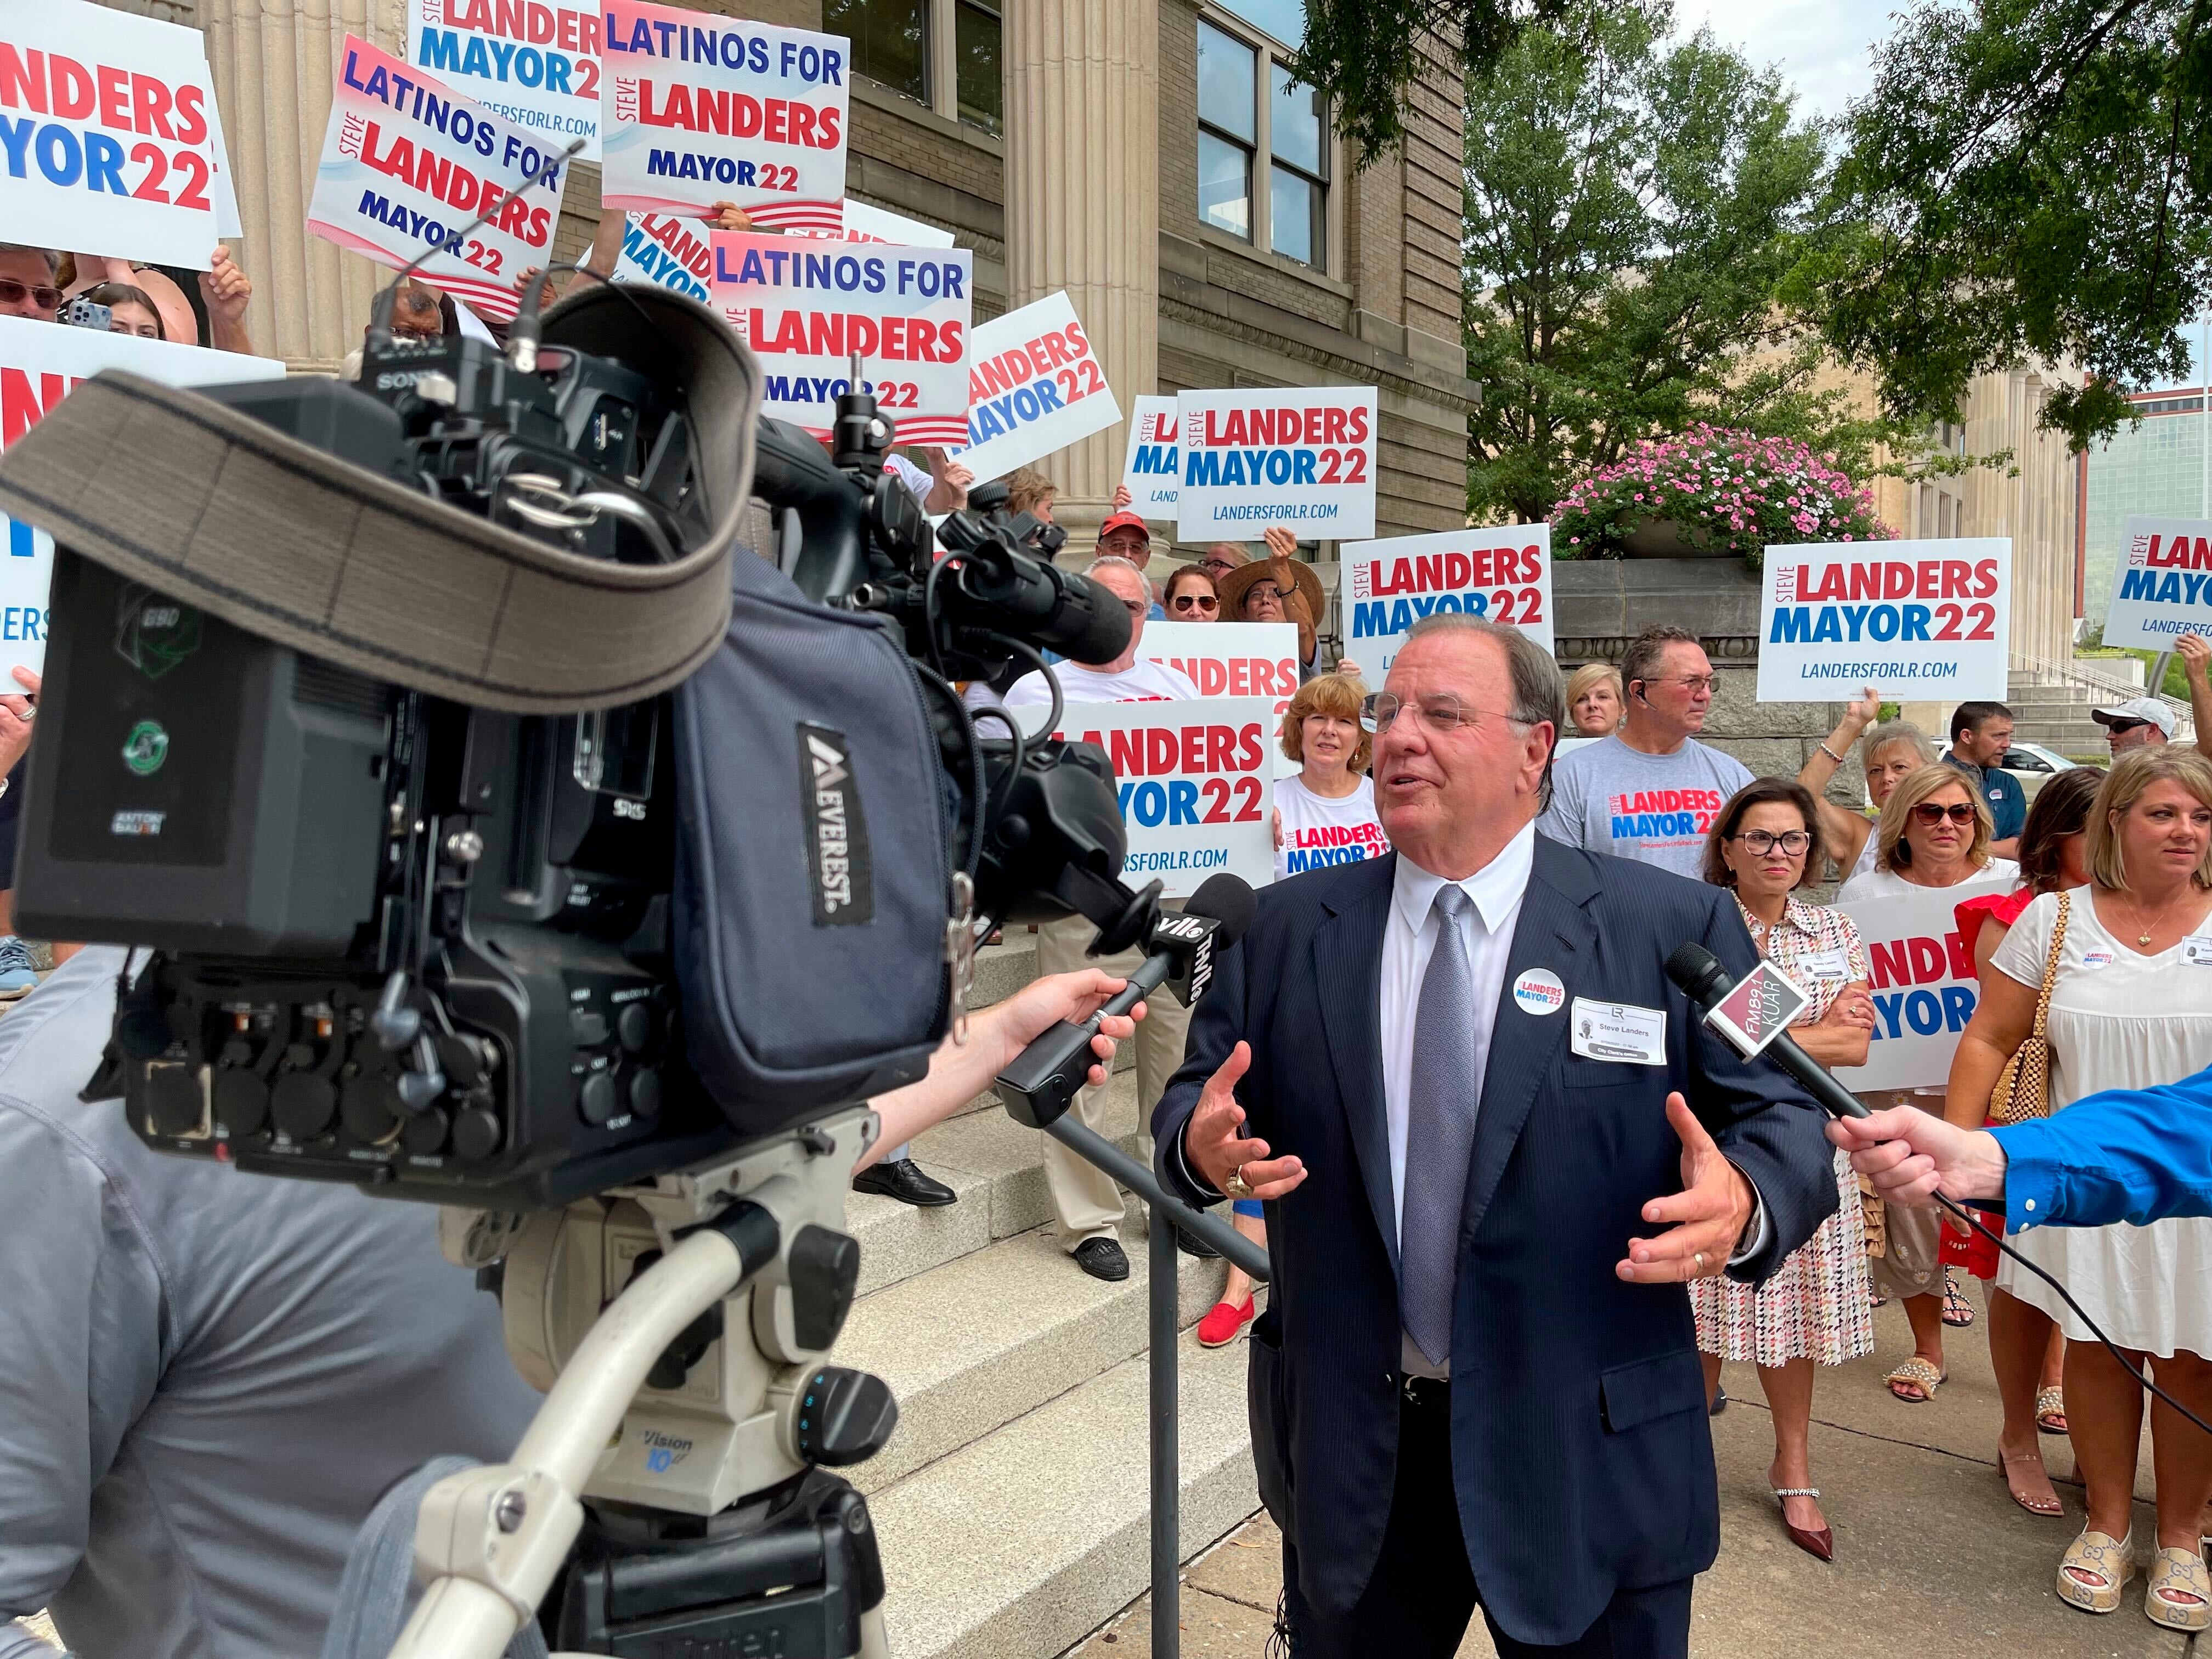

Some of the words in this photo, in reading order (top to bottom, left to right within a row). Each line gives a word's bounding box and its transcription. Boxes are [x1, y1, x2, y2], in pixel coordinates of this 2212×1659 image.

[443, 0, 601, 57] LANDER
[607, 13, 769, 74] LATINOS
[781, 42, 842, 86] FOR
[0, 42, 207, 145] NDERS
[617, 76, 636, 122] STEVE
[343, 50, 495, 156] LATINOS
[503, 135, 559, 193] FOR
[478, 101, 596, 137] ERSFORLR.COM
[639, 78, 840, 150] LANDERS
[339, 111, 365, 159] STEVE
[360, 121, 551, 247] LANDERS
[623, 219, 710, 307] MAYOR
[640, 213, 711, 289] LAND
[716, 246, 886, 295] LATINOS
[898, 261, 964, 299] FOR
[749, 308, 963, 364] LANDERS
[377, 371, 432, 391] SON
[1141, 413, 1155, 442] STEVE
[1188, 411, 1203, 447] STEVE
[1206, 407, 1368, 446] LANDERS
[1214, 504, 1338, 520] LANDERSFORLR.COM
[2130, 534, 2149, 566] STEVE
[2146, 534, 2212, 571] LAN
[1353, 562, 1369, 598] STEVE
[1372, 545, 1542, 597] LANDERS
[1776, 566, 1795, 602] STEVE
[1796, 558, 1999, 602] LANDERS
[1149, 658, 1297, 696] DERS
[1801, 662, 1957, 679] LANDERSFORLR.COM
[1052, 723, 1263, 777] NDERS
[1609, 795, 1622, 815] STEVE
[1620, 789, 1722, 814] LANDERS
[1285, 831, 1296, 850] STEVE
[1295, 823, 1384, 848] LANDERS
[1867, 933, 1972, 990] NDE
[1522, 981, 1562, 997] LANDERS
[1762, 980, 1780, 1027] KUAR
[1599, 1023, 1620, 1032] Steve
[1621, 1026, 1650, 1037] Landers
[645, 1431, 693, 1451] Vision
